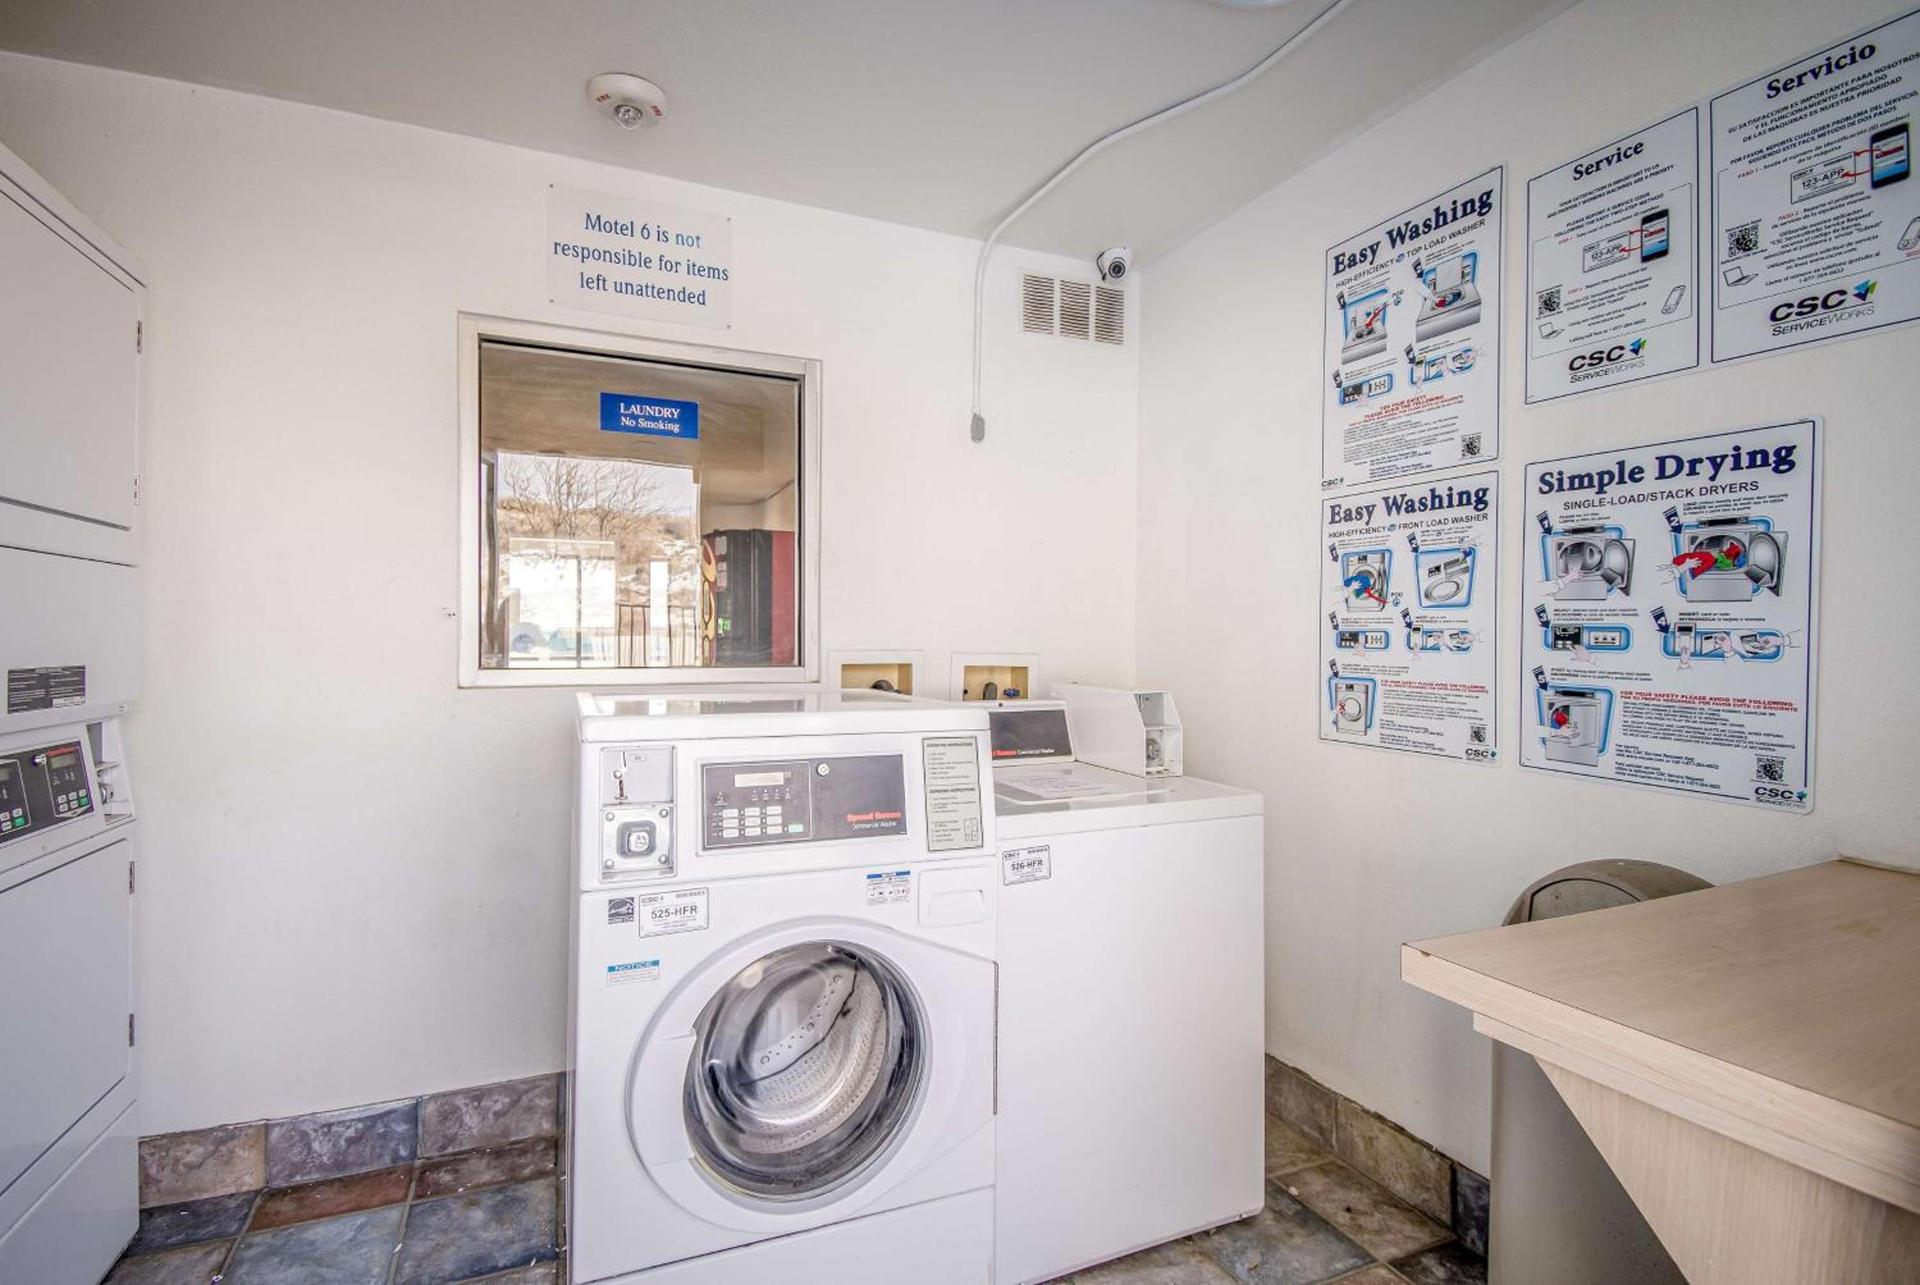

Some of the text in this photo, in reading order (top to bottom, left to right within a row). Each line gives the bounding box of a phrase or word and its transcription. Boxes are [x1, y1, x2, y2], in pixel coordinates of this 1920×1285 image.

[1766, 44, 1876, 99] Servicio
[1738, 104, 1788, 130] SATISFACCION
[1799, 79, 1848, 105] IMPORTANTE
[1850, 69, 1872, 84] PARA
[1873, 49, 1920, 75] NOSOTROS
[1769, 91, 1838, 125] FUNCIONAMIENTO
[1839, 71, 1887, 97] APROPIADO
[1742, 134, 1751, 143] DE
[1752, 127, 1767, 139] LAS
[1767, 111, 1807, 133] MAQUINAS
[1819, 92, 1854, 112] NUESTRA
[1856, 74, 1902, 98] PRIORIDAD
[1572, 142, 1645, 182] Service
[1730, 155, 1742, 165] POR
[1802, 168, 1844, 189] 123-APP
[584, 212, 701, 249] Motel 6 is not
[1332, 240, 1381, 276] Easy
[1386, 188, 1494, 250] Washing
[553, 241, 730, 281] responsible for items
[1335, 258, 1395, 289] HIGH-EFFICIENCY
[1406, 244, 1423, 259] TOP
[1424, 236, 1447, 251] LOAD
[1449, 218, 1486, 240] WASHER
[580, 272, 707, 306] left unattended
[1769, 289, 1848, 323] CSC
[1568, 345, 1626, 372] CSC
[619, 403, 681, 419] LAUNDRY
[620, 416, 680, 433] No Smoking
[1538, 444, 1797, 495] Simple Drying
[1328, 486, 1489, 527] Easy Washing
[1563, 489, 1695, 511] SINGLE-LOAD/STACK
[1699, 480, 1760, 497] DRYERS
[1328, 512, 1489, 539] HIGH-EFFICIENCY FRONT LOAD WASHER
[1669, 515, 1679, 527] 2
[1538, 611, 1548, 624] 3
[1658, 613, 1668, 625] 4
[1537, 673, 1547, 685] 5
[1747, 697, 1793, 707] FOLLOWING
[1465, 748, 1489, 758] CSC
[1754, 786, 1794, 800] CSC
[1010, 859, 1044, 871] 526-HFR
[651, 905, 698, 920] 525-HFR
[615, 961, 650, 972] NOTICE
